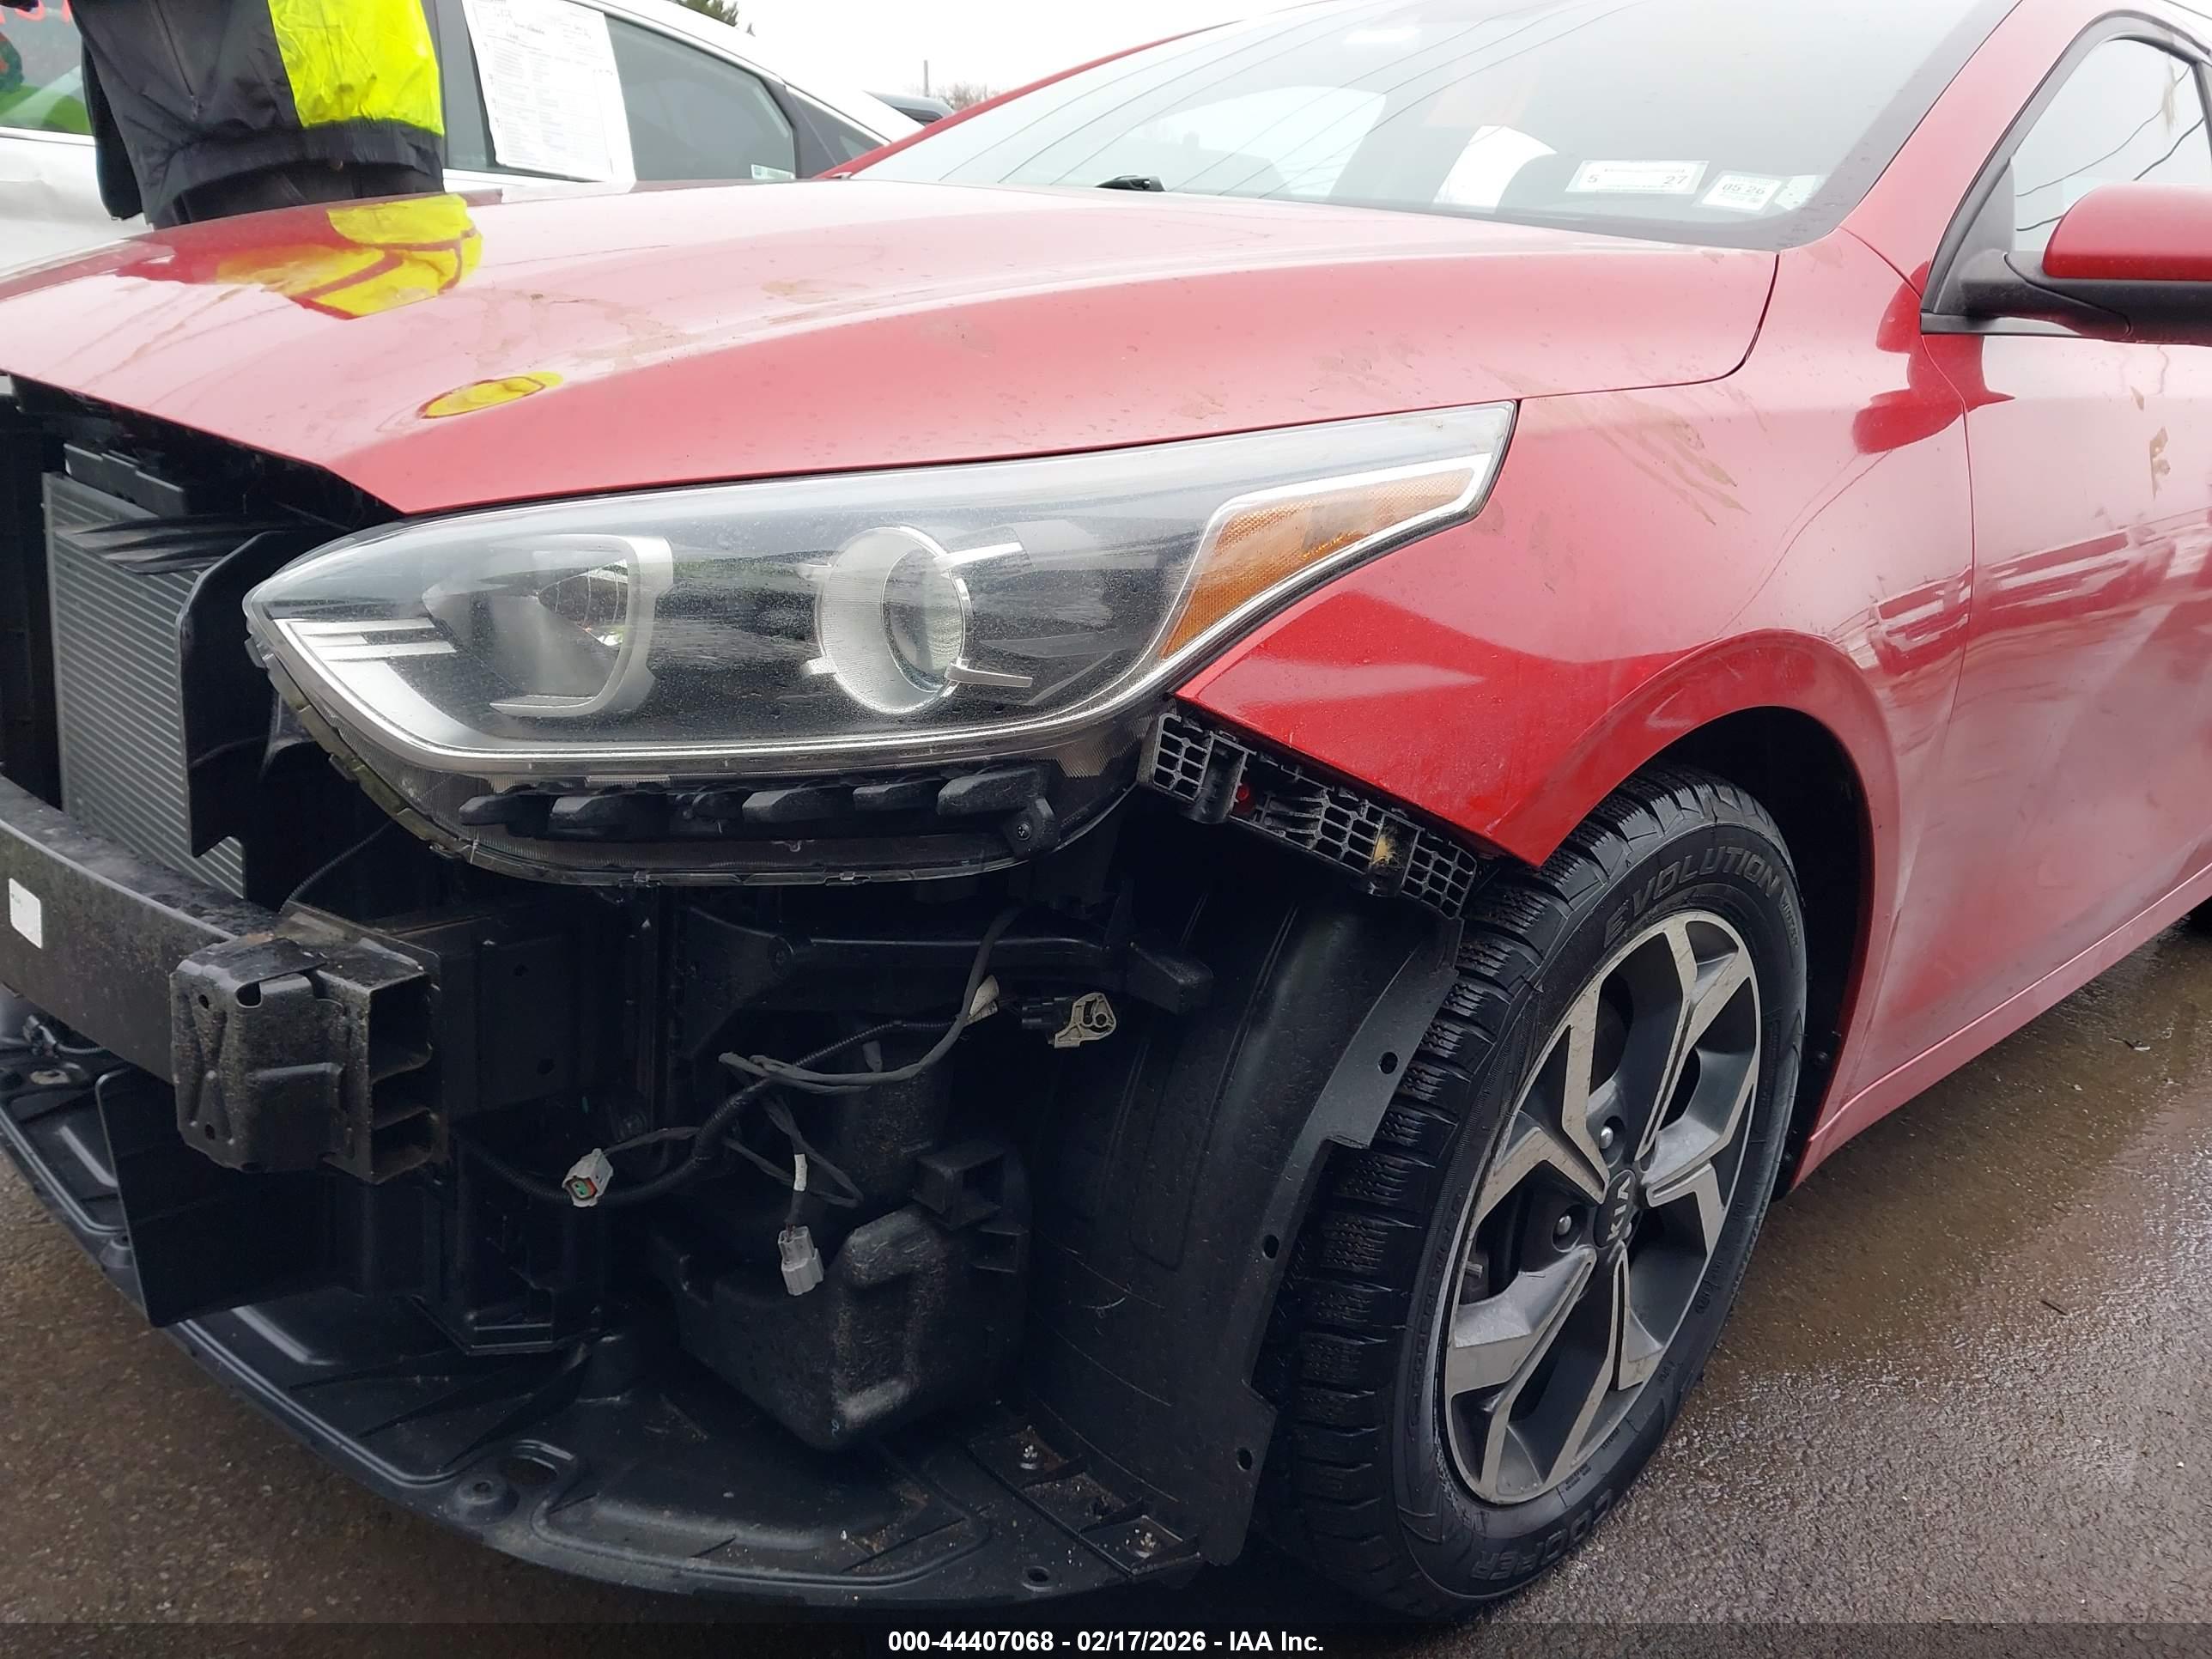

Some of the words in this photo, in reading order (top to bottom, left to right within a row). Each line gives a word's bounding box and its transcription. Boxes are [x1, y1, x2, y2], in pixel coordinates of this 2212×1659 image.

[1587, 174, 1600, 184] 5
[1663, 174, 1688, 185] 27
[1746, 185, 1766, 195] 26
[1603, 845, 1781, 949] EVOLUTION
[1606, 1176, 1632, 1243] KIA
